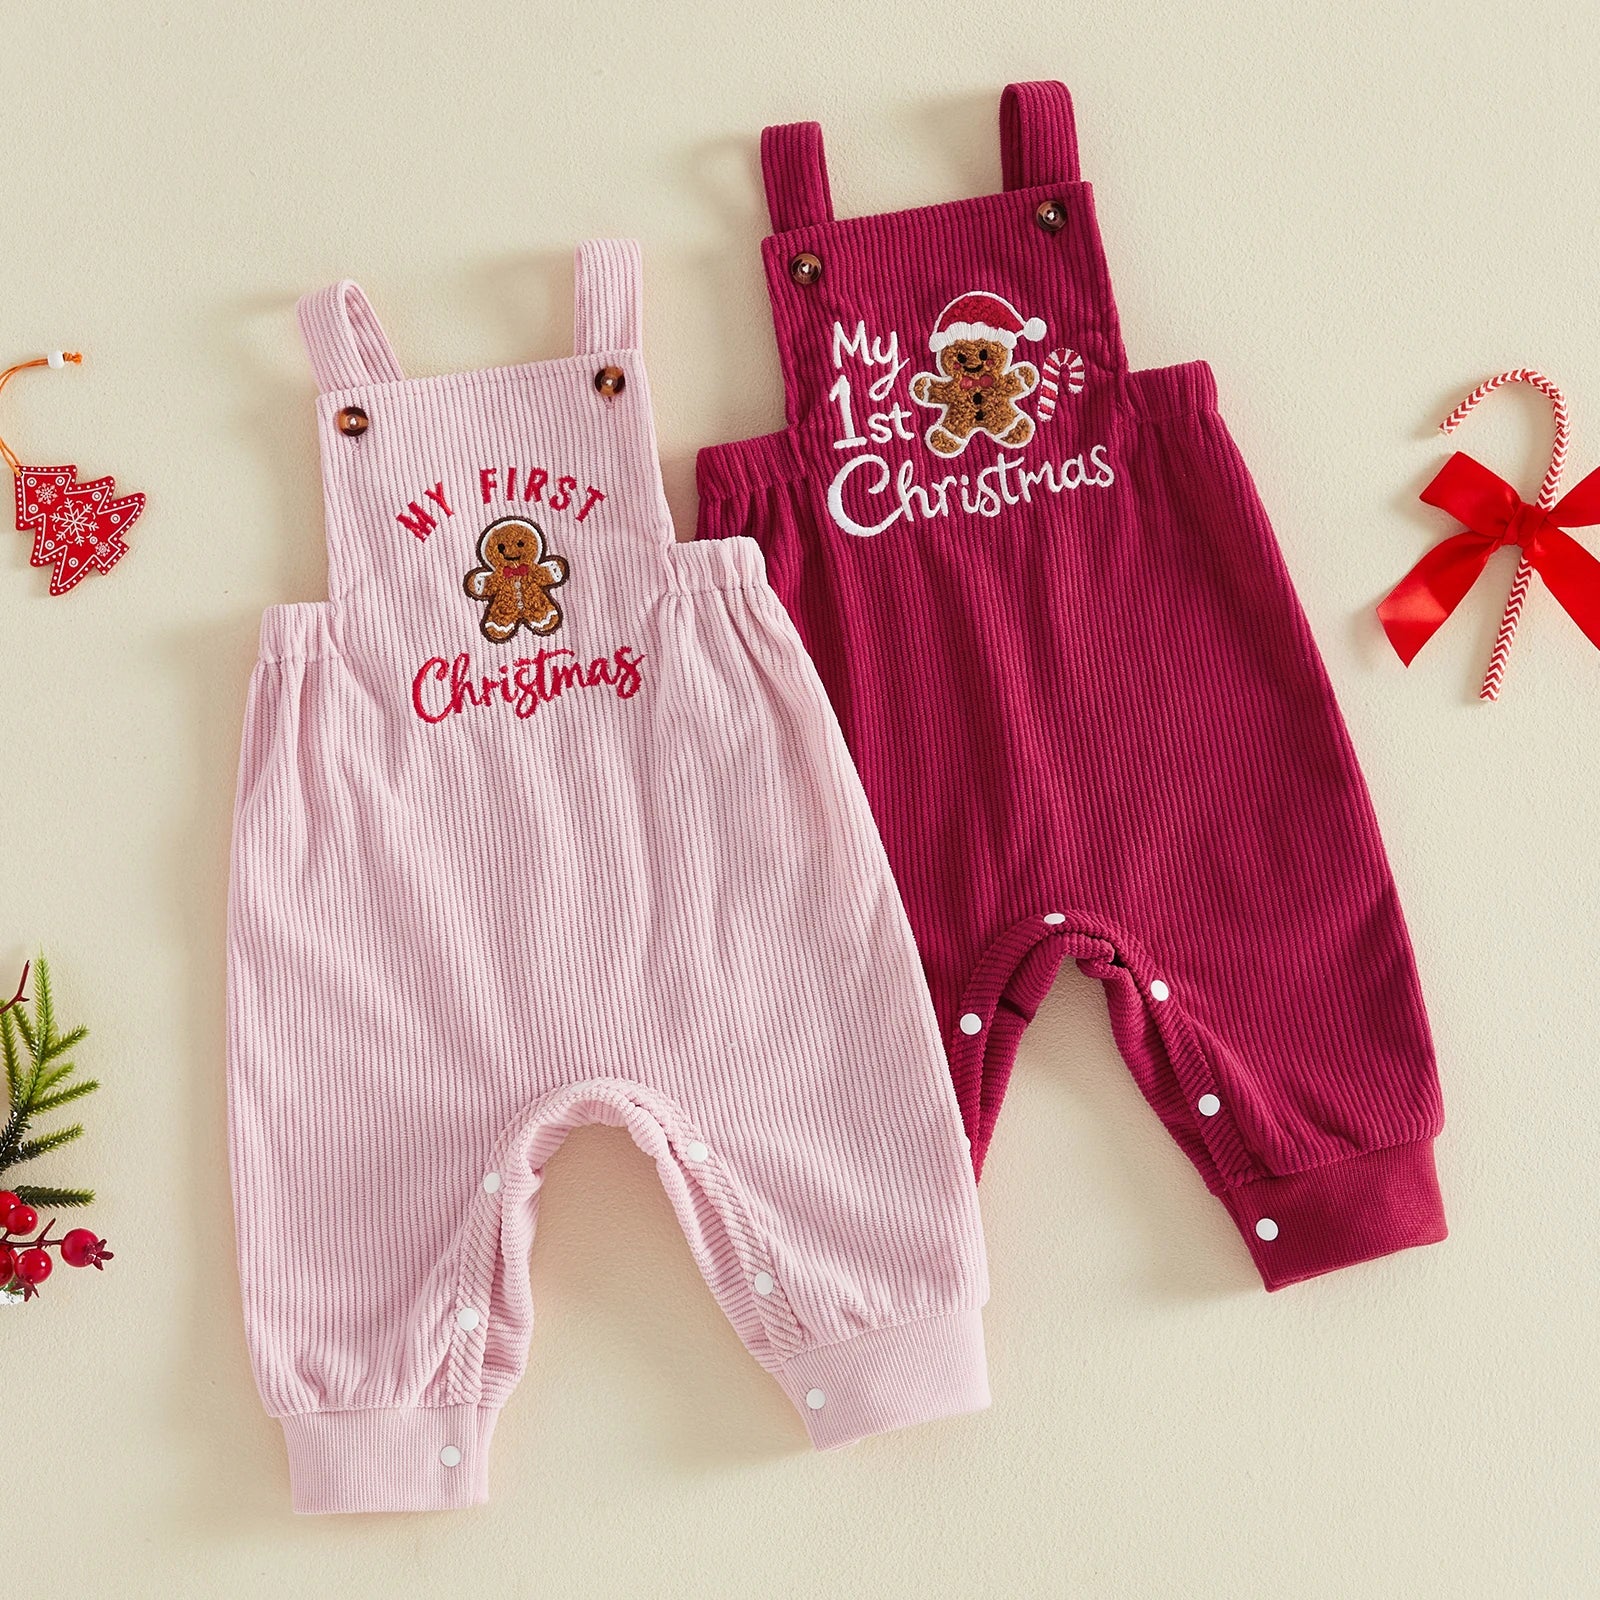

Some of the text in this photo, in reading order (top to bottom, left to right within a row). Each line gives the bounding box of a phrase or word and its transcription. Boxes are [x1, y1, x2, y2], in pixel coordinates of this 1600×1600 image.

[832, 320, 910, 401] My
[829, 374, 914, 449] 1st
[396, 467, 607, 543] MY FIRST
[827, 444, 1115, 537] Christmas
[412, 646, 645, 724] Christmas
